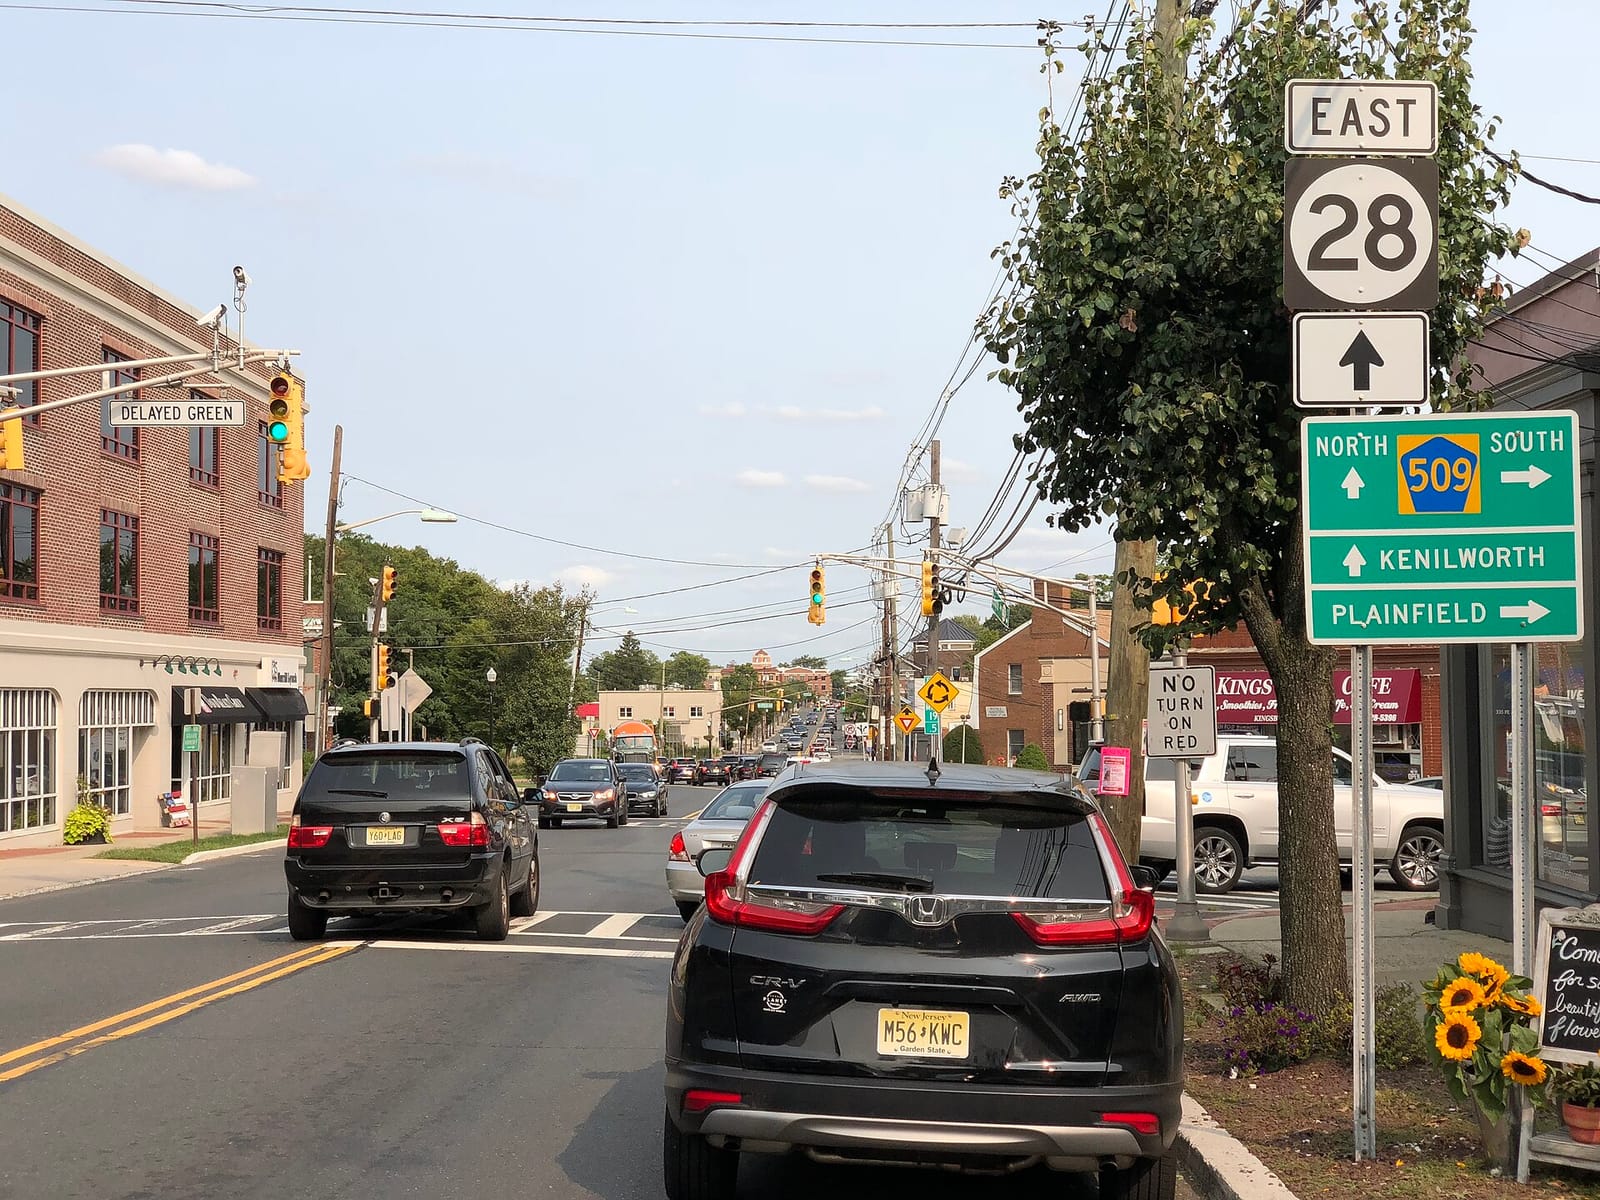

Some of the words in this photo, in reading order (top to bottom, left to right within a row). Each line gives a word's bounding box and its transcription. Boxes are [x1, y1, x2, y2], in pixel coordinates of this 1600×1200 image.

[1311, 97, 1417, 137] EAST
[1307, 193, 1417, 272] 28
[121, 406, 181, 420] DELAYED
[188, 406, 233, 420] GREEN
[1316, 435, 1388, 457] NORTH
[1490, 430, 1564, 453] SOUTH
[1408, 457, 1472, 493] 509
[1380, 546, 1545, 570] KENILWORTH
[1332, 602, 1487, 625] PLAINFIELD
[1163, 675, 1195, 692] NO
[1341, 675, 1392, 695] CFE
[1156, 697, 1203, 711] TURN
[930, 711, 937, 720] 19
[1169, 716, 1192, 730] ON
[1164, 735, 1197, 749] RED
[750, 975, 806, 988] CR-V
[1553, 969, 1584, 991] for
[1059, 993, 1101, 1002] AWD
[901, 1011, 920, 1019] New
[922, 1012, 947, 1021] Jersey
[900, 1045, 925, 1053] Garden
